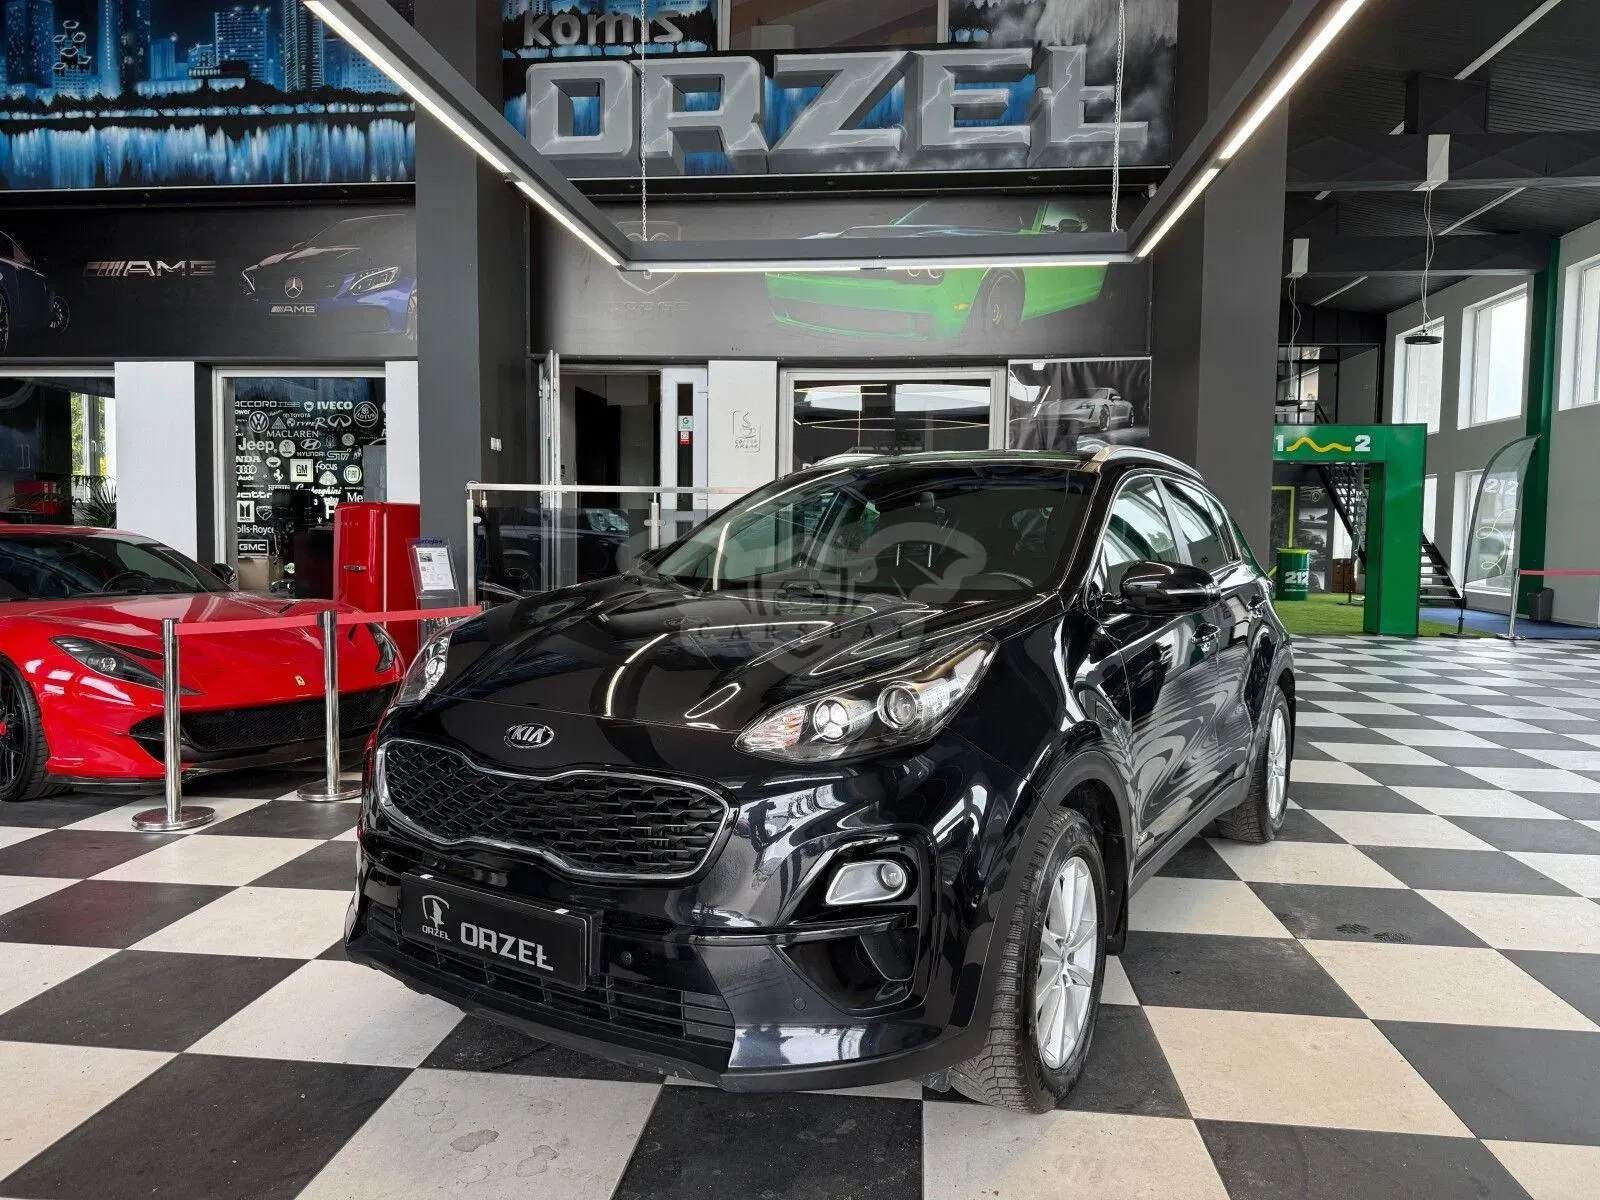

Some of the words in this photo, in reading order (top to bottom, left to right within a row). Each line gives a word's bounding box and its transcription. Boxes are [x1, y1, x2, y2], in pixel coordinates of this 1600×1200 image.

[523, 10, 684, 47] komis
[525, 44, 1149, 168] ORZEŁ
[122, 260, 216, 277] AMG
[283, 305, 316, 313] AMG
[316, 400, 354, 410] IVECO
[266, 430, 320, 438] MACLAREN
[238, 437, 275, 453] Jeep
[296, 464, 308, 474] GM
[1485, 478, 1519, 496] 212
[238, 543, 267, 551] GMC
[1284, 571, 1309, 585] 212
[511, 725, 545, 743] KIA
[422, 924, 451, 941] ORZEŁ
[460, 921, 554, 972] ORZEŁ
